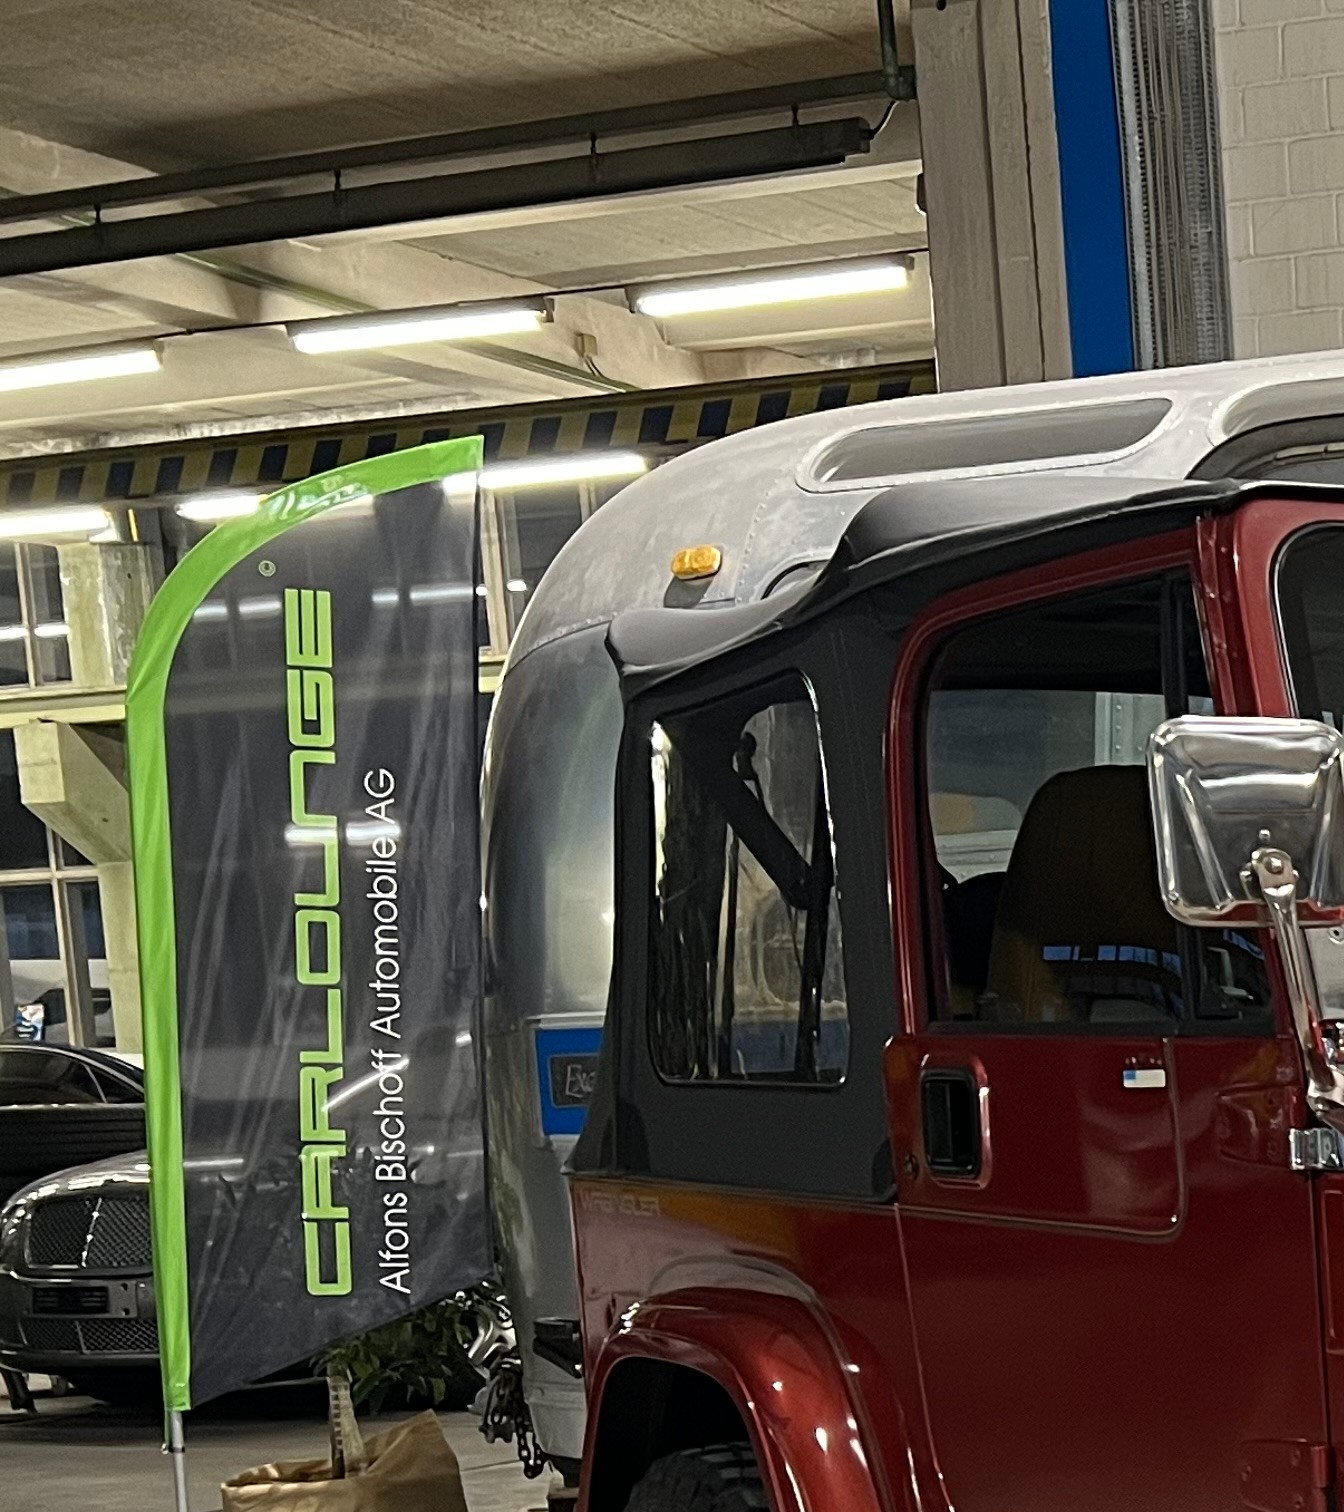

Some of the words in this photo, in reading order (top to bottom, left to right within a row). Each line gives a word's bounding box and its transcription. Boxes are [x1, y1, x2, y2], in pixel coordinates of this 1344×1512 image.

[362, 767, 396, 822] AG
[286, 588, 351, 1296] CARLOUNGE
[365, 835, 402, 1039] Automobile
[369, 1047, 409, 1182] Bischoff
[377, 1191, 412, 1295] Alfons
